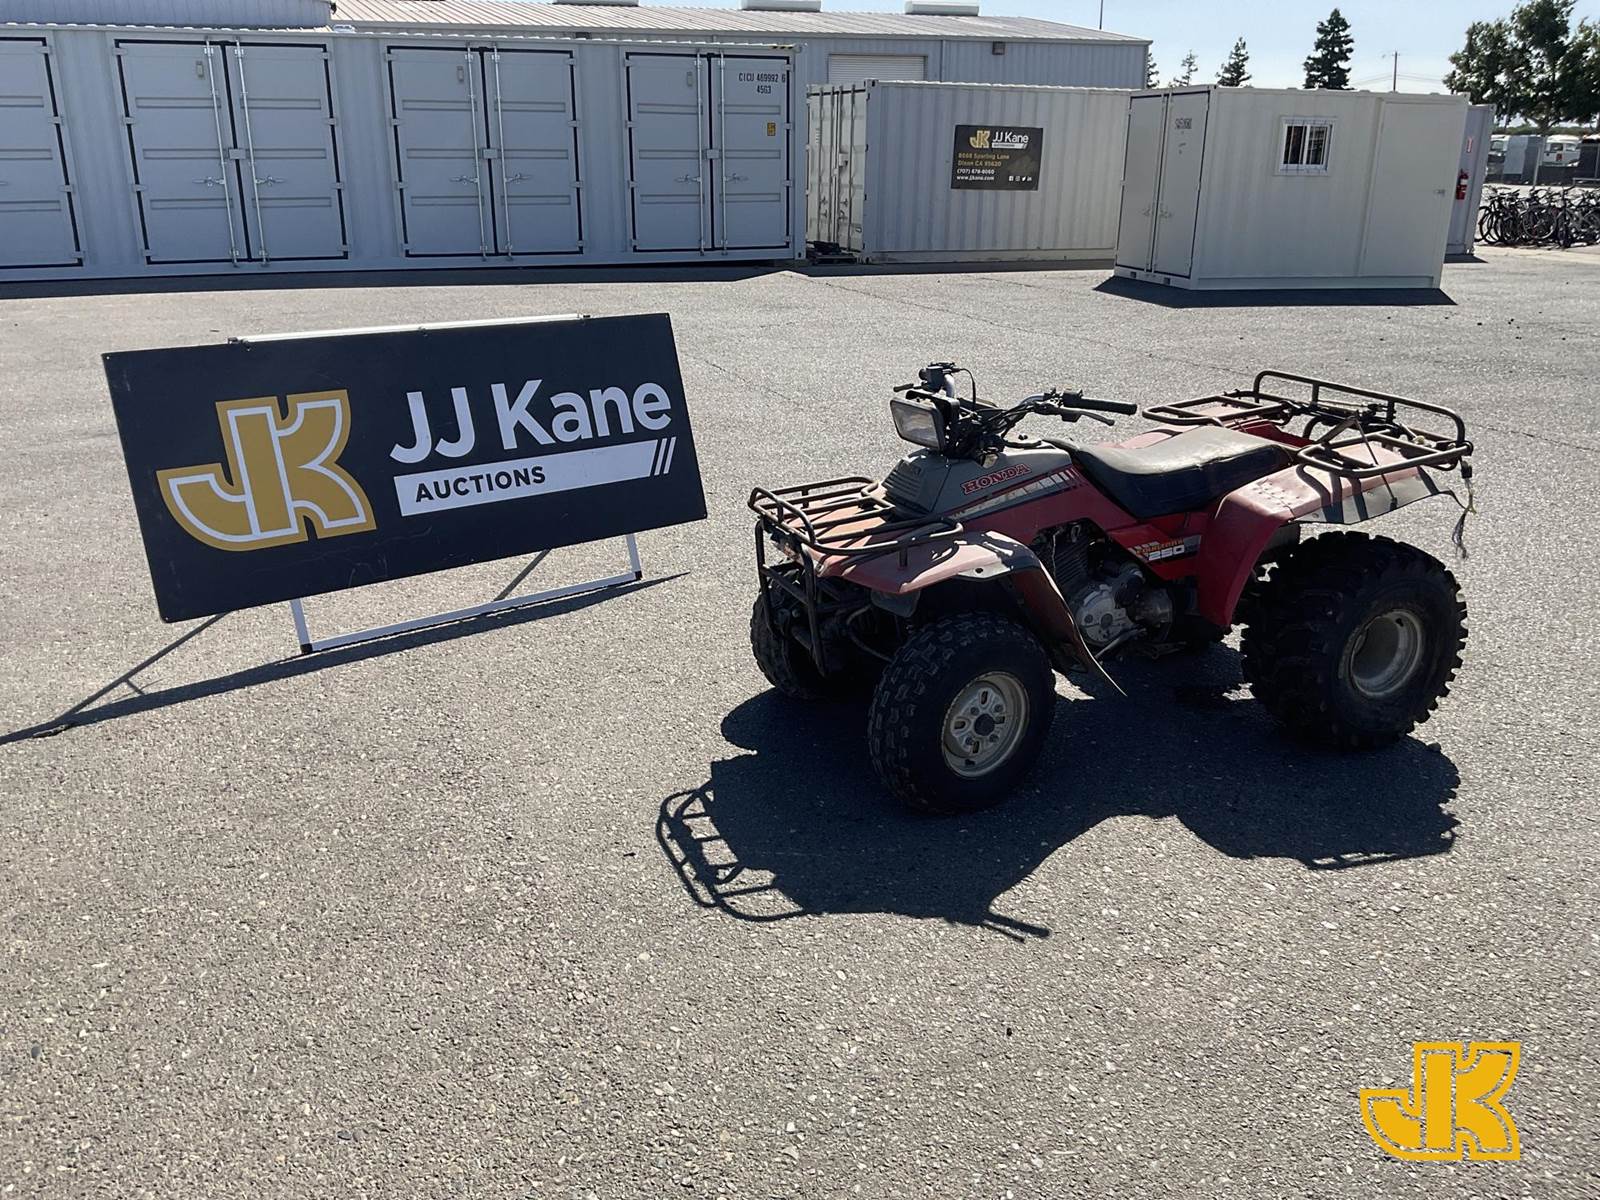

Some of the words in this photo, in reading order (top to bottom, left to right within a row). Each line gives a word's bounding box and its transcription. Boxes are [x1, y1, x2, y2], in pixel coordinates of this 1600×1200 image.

[739, 72, 754, 82] CICU
[757, 73, 778, 83] 469992
[782, 73, 785, 83] 6
[993, 131, 1002, 143] JJ
[1005, 131, 1029, 144] Kane
[389, 386, 476, 464] JJ
[491, 379, 672, 450] Kane
[415, 465, 546, 502] AUCTIONS
[961, 463, 1032, 494] HONDA
[1148, 544, 1185, 561] 250
